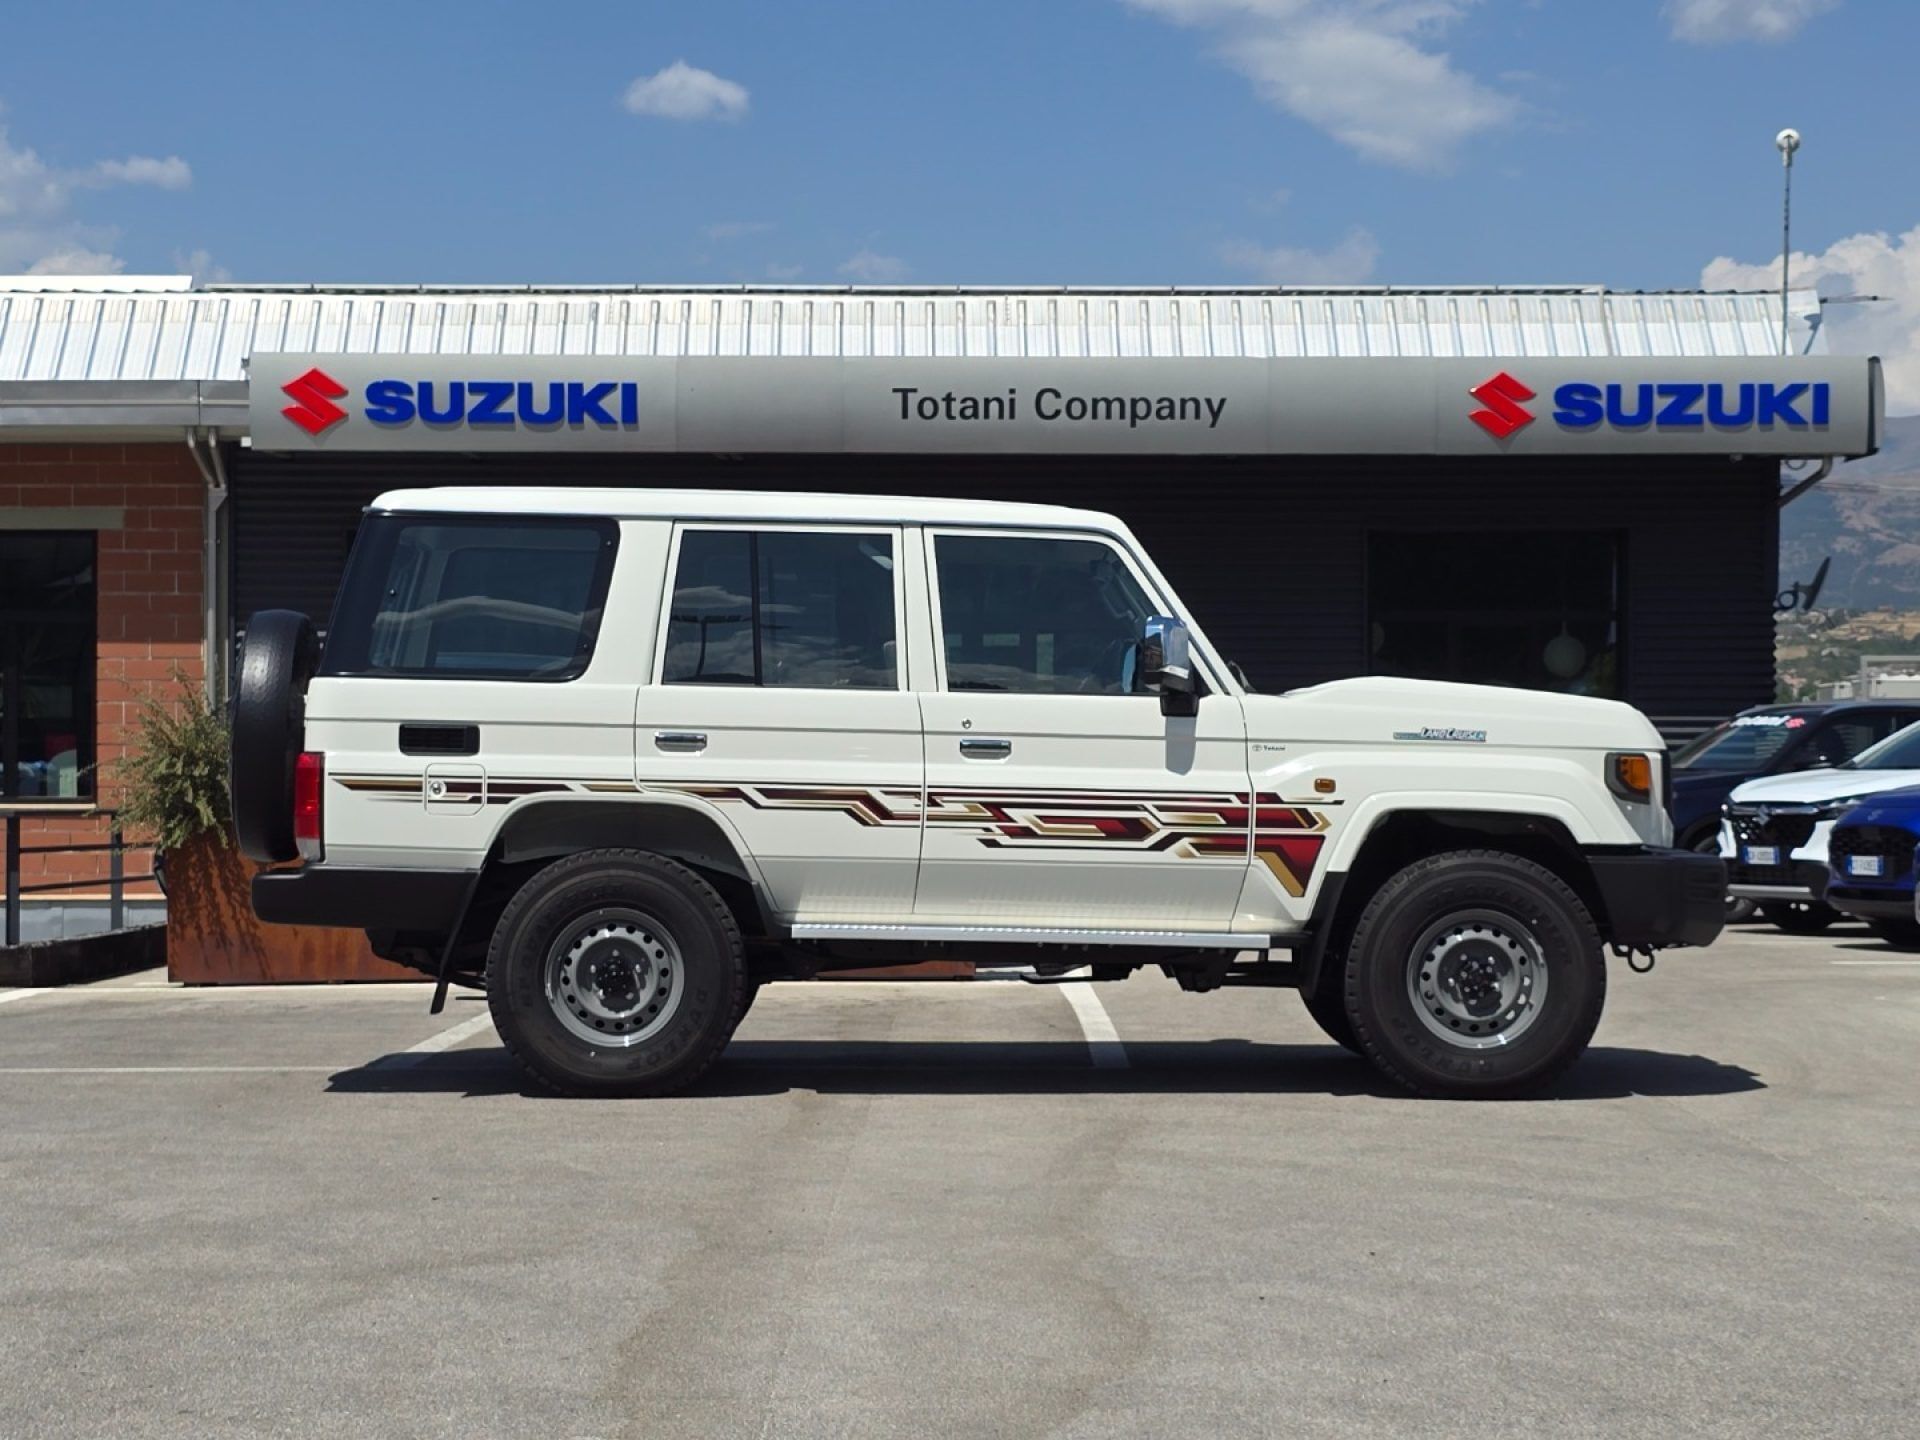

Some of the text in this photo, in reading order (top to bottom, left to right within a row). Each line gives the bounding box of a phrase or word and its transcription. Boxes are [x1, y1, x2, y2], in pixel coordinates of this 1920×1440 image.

[365, 380, 638, 424] SUZUKI
[892, 388, 1225, 428] Totani Company
[1553, 383, 1829, 425] SUZUKI
